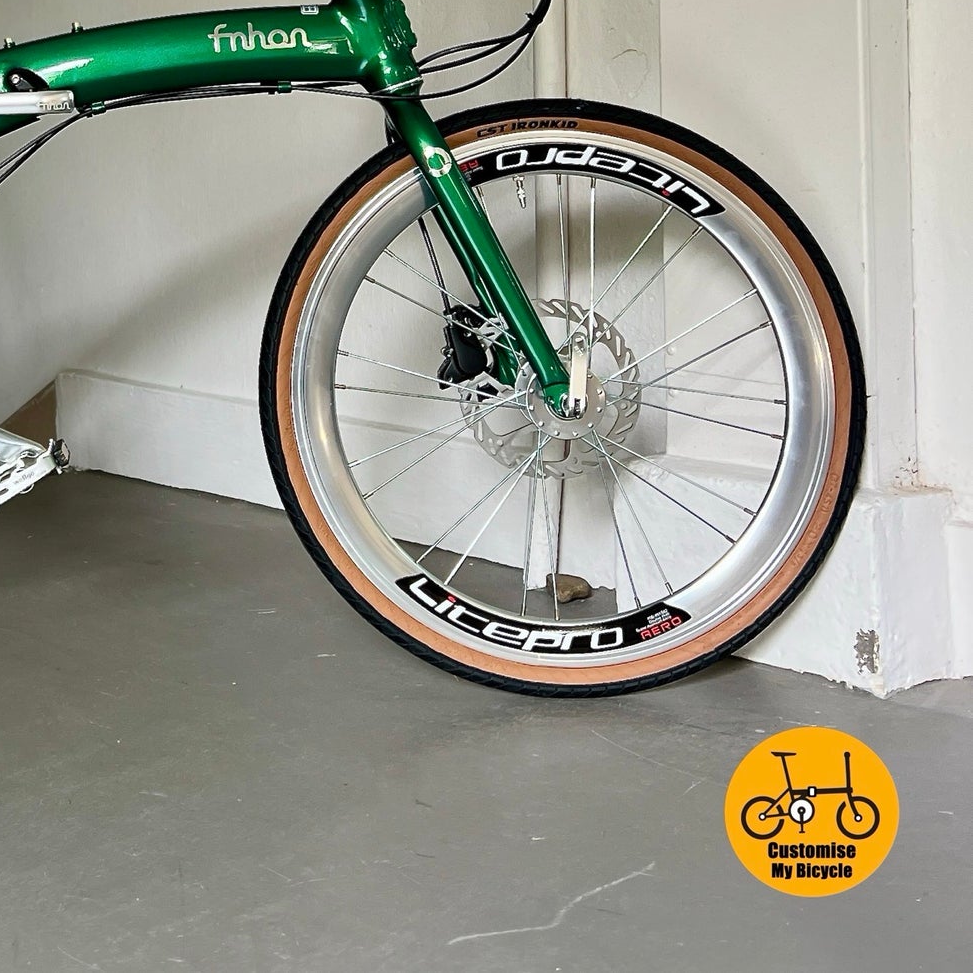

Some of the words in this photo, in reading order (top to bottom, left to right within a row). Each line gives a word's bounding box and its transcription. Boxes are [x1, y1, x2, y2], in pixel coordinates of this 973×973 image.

[208, 22, 312, 53] fnhon
[476, 123, 508, 138] CST
[511, 119, 579, 131] IRONKID
[496, 146, 710, 215] Litepro
[409, 577, 624, 651] Litepro
[640, 616, 682, 640] AERO
